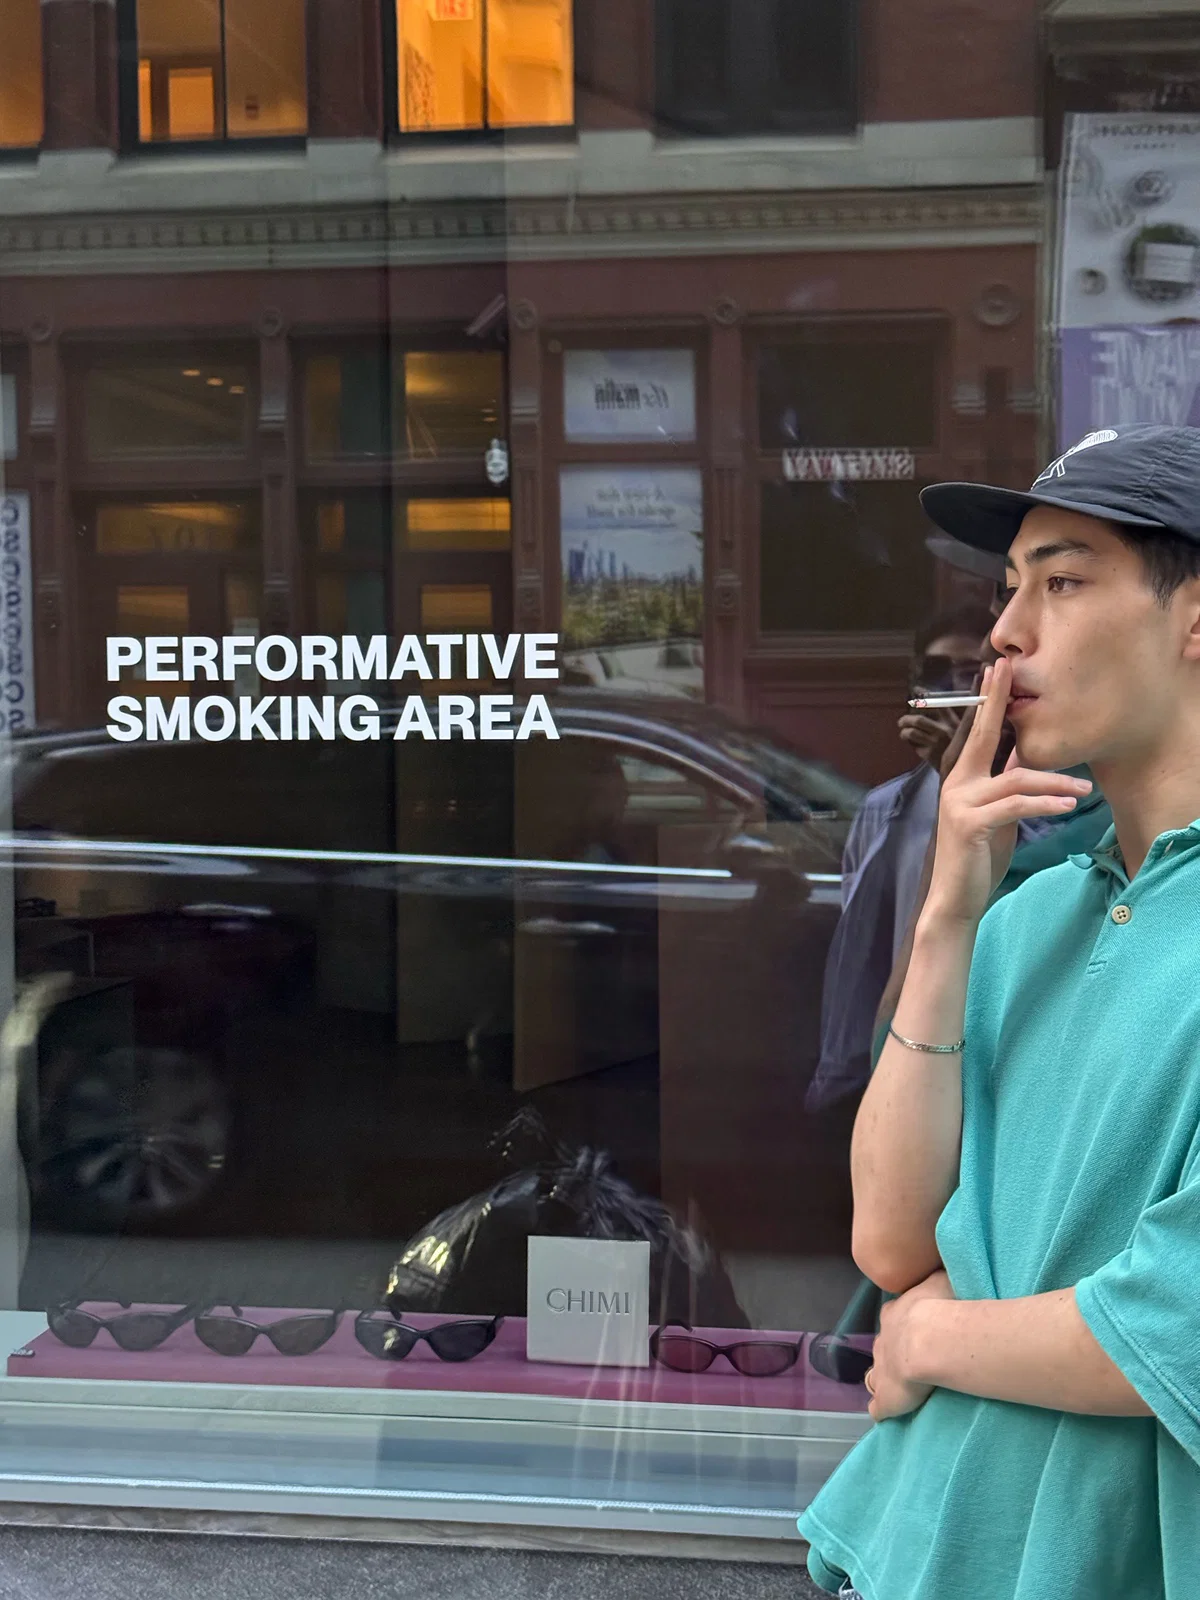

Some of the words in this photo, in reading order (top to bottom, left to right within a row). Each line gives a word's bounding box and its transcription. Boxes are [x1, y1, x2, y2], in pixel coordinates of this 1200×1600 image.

[105, 633, 560, 682] PERFORMATIVE
[105, 694, 381, 742] SMOKING
[393, 694, 561, 741] AREA
[546, 1287, 630, 1315] CHIMI
